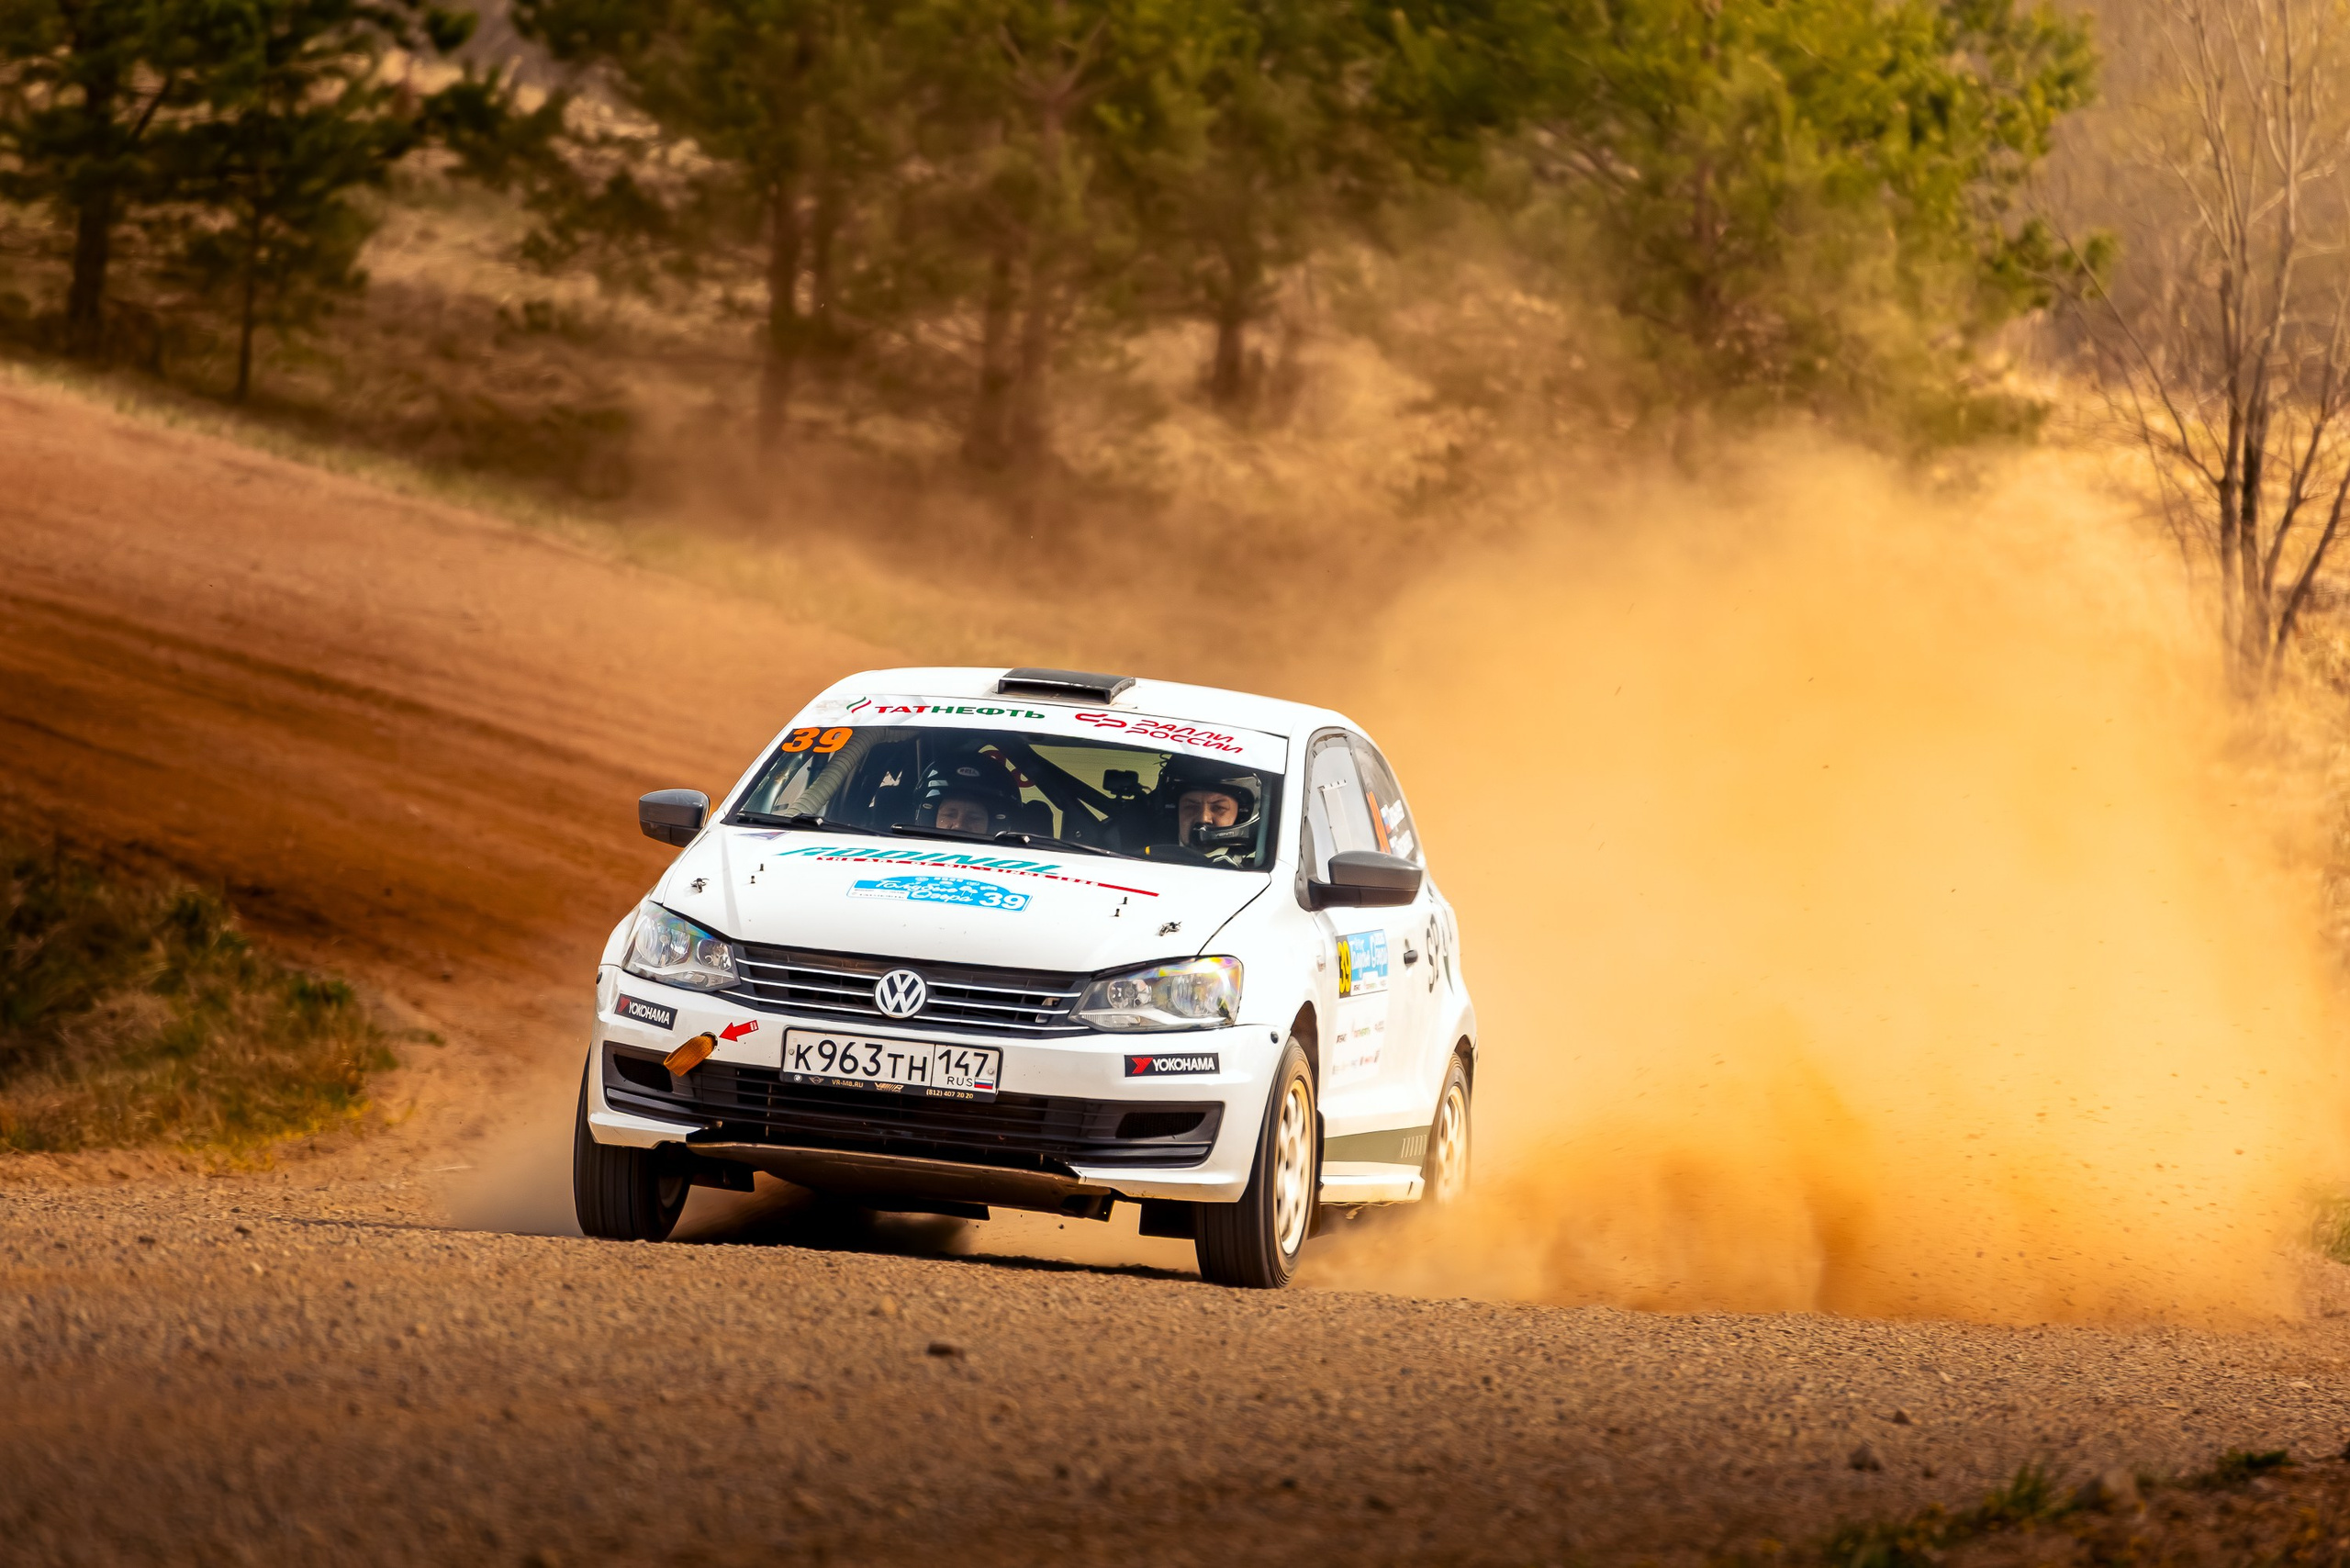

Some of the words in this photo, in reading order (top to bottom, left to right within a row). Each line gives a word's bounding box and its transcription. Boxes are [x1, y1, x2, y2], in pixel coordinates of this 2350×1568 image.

[875, 705, 1045, 720] ТАТНЕФТЬ
[781, 727, 854, 754] 39
[1125, 726, 1244, 754] РОССИИ
[979, 892, 1026, 910] 39
[1337, 940, 1351, 993] 39
[629, 1001, 670, 1025] YOKOHAMA
[937, 1049, 990, 1078] 147
[1153, 1057, 1215, 1072] YOKOHAMA
[947, 1076, 973, 1087] RUS
